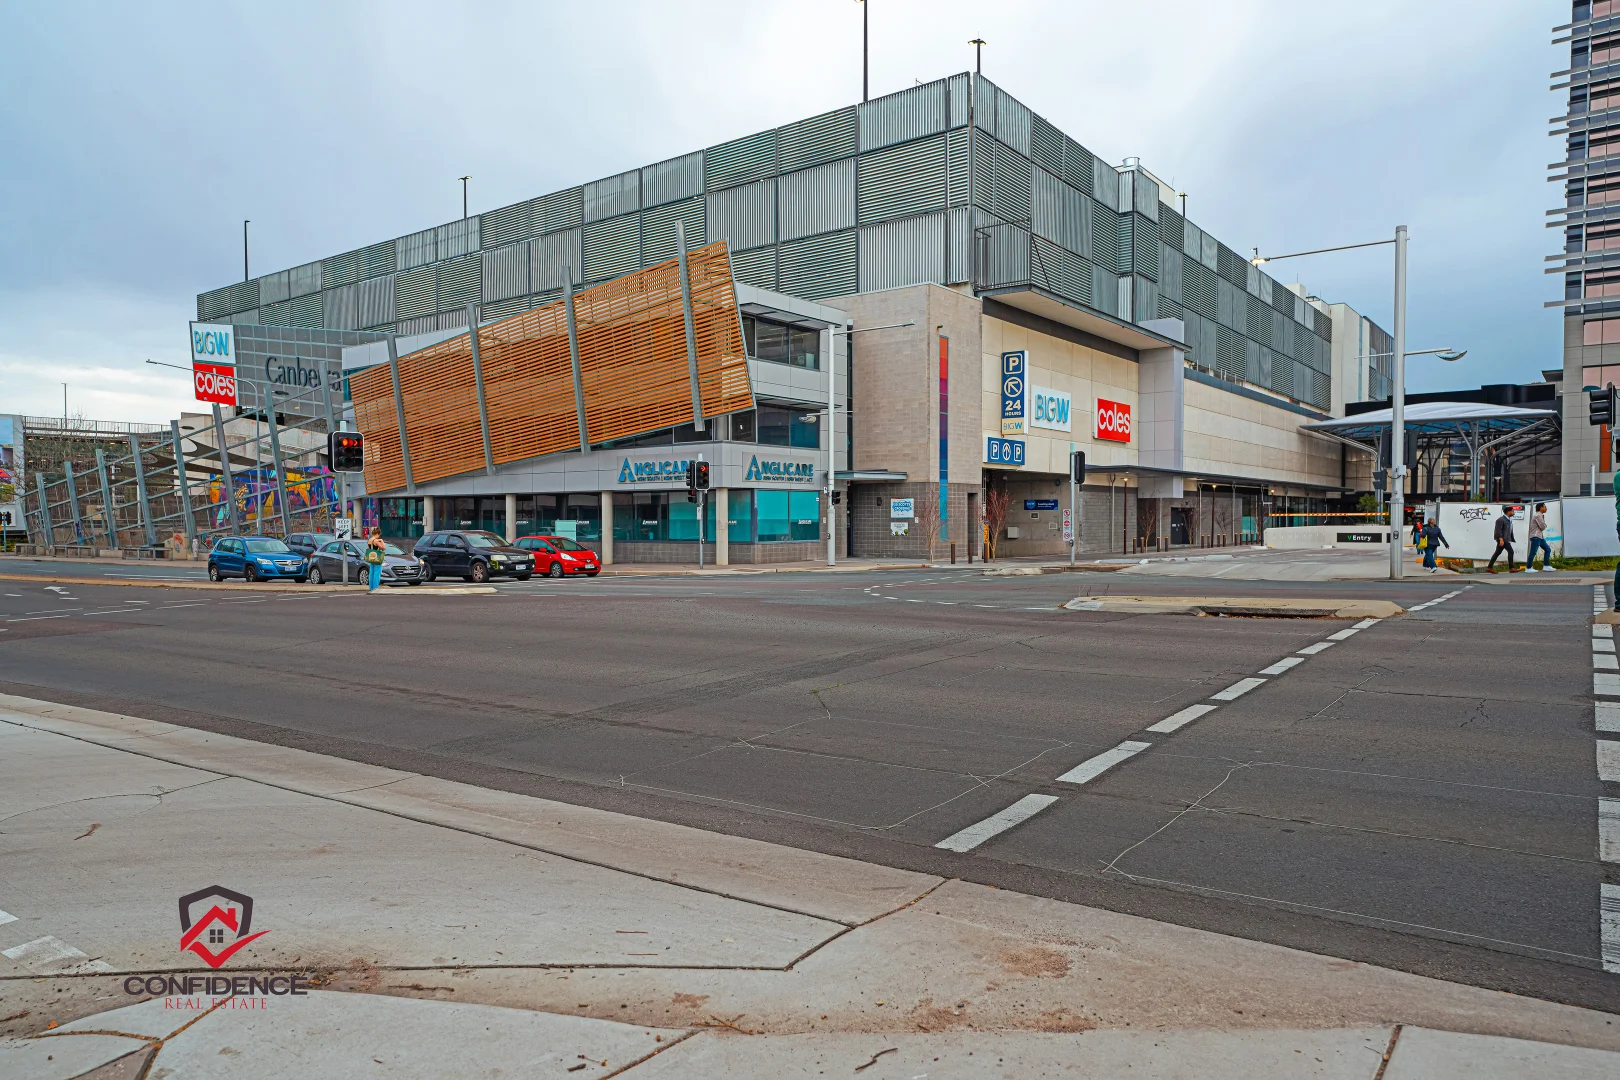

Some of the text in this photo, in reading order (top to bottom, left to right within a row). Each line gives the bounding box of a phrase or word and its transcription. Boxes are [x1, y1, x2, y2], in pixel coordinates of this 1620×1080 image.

[1009, 357, 1019, 371] P
[195, 368, 235, 397] coles
[1005, 399, 1021, 411] 24
[1098, 403, 1131, 434] coles
[618, 456, 696, 483] ANGLICAR
[745, 454, 815, 481] ANGLICARE
[1352, 534, 1372, 542] Entry
